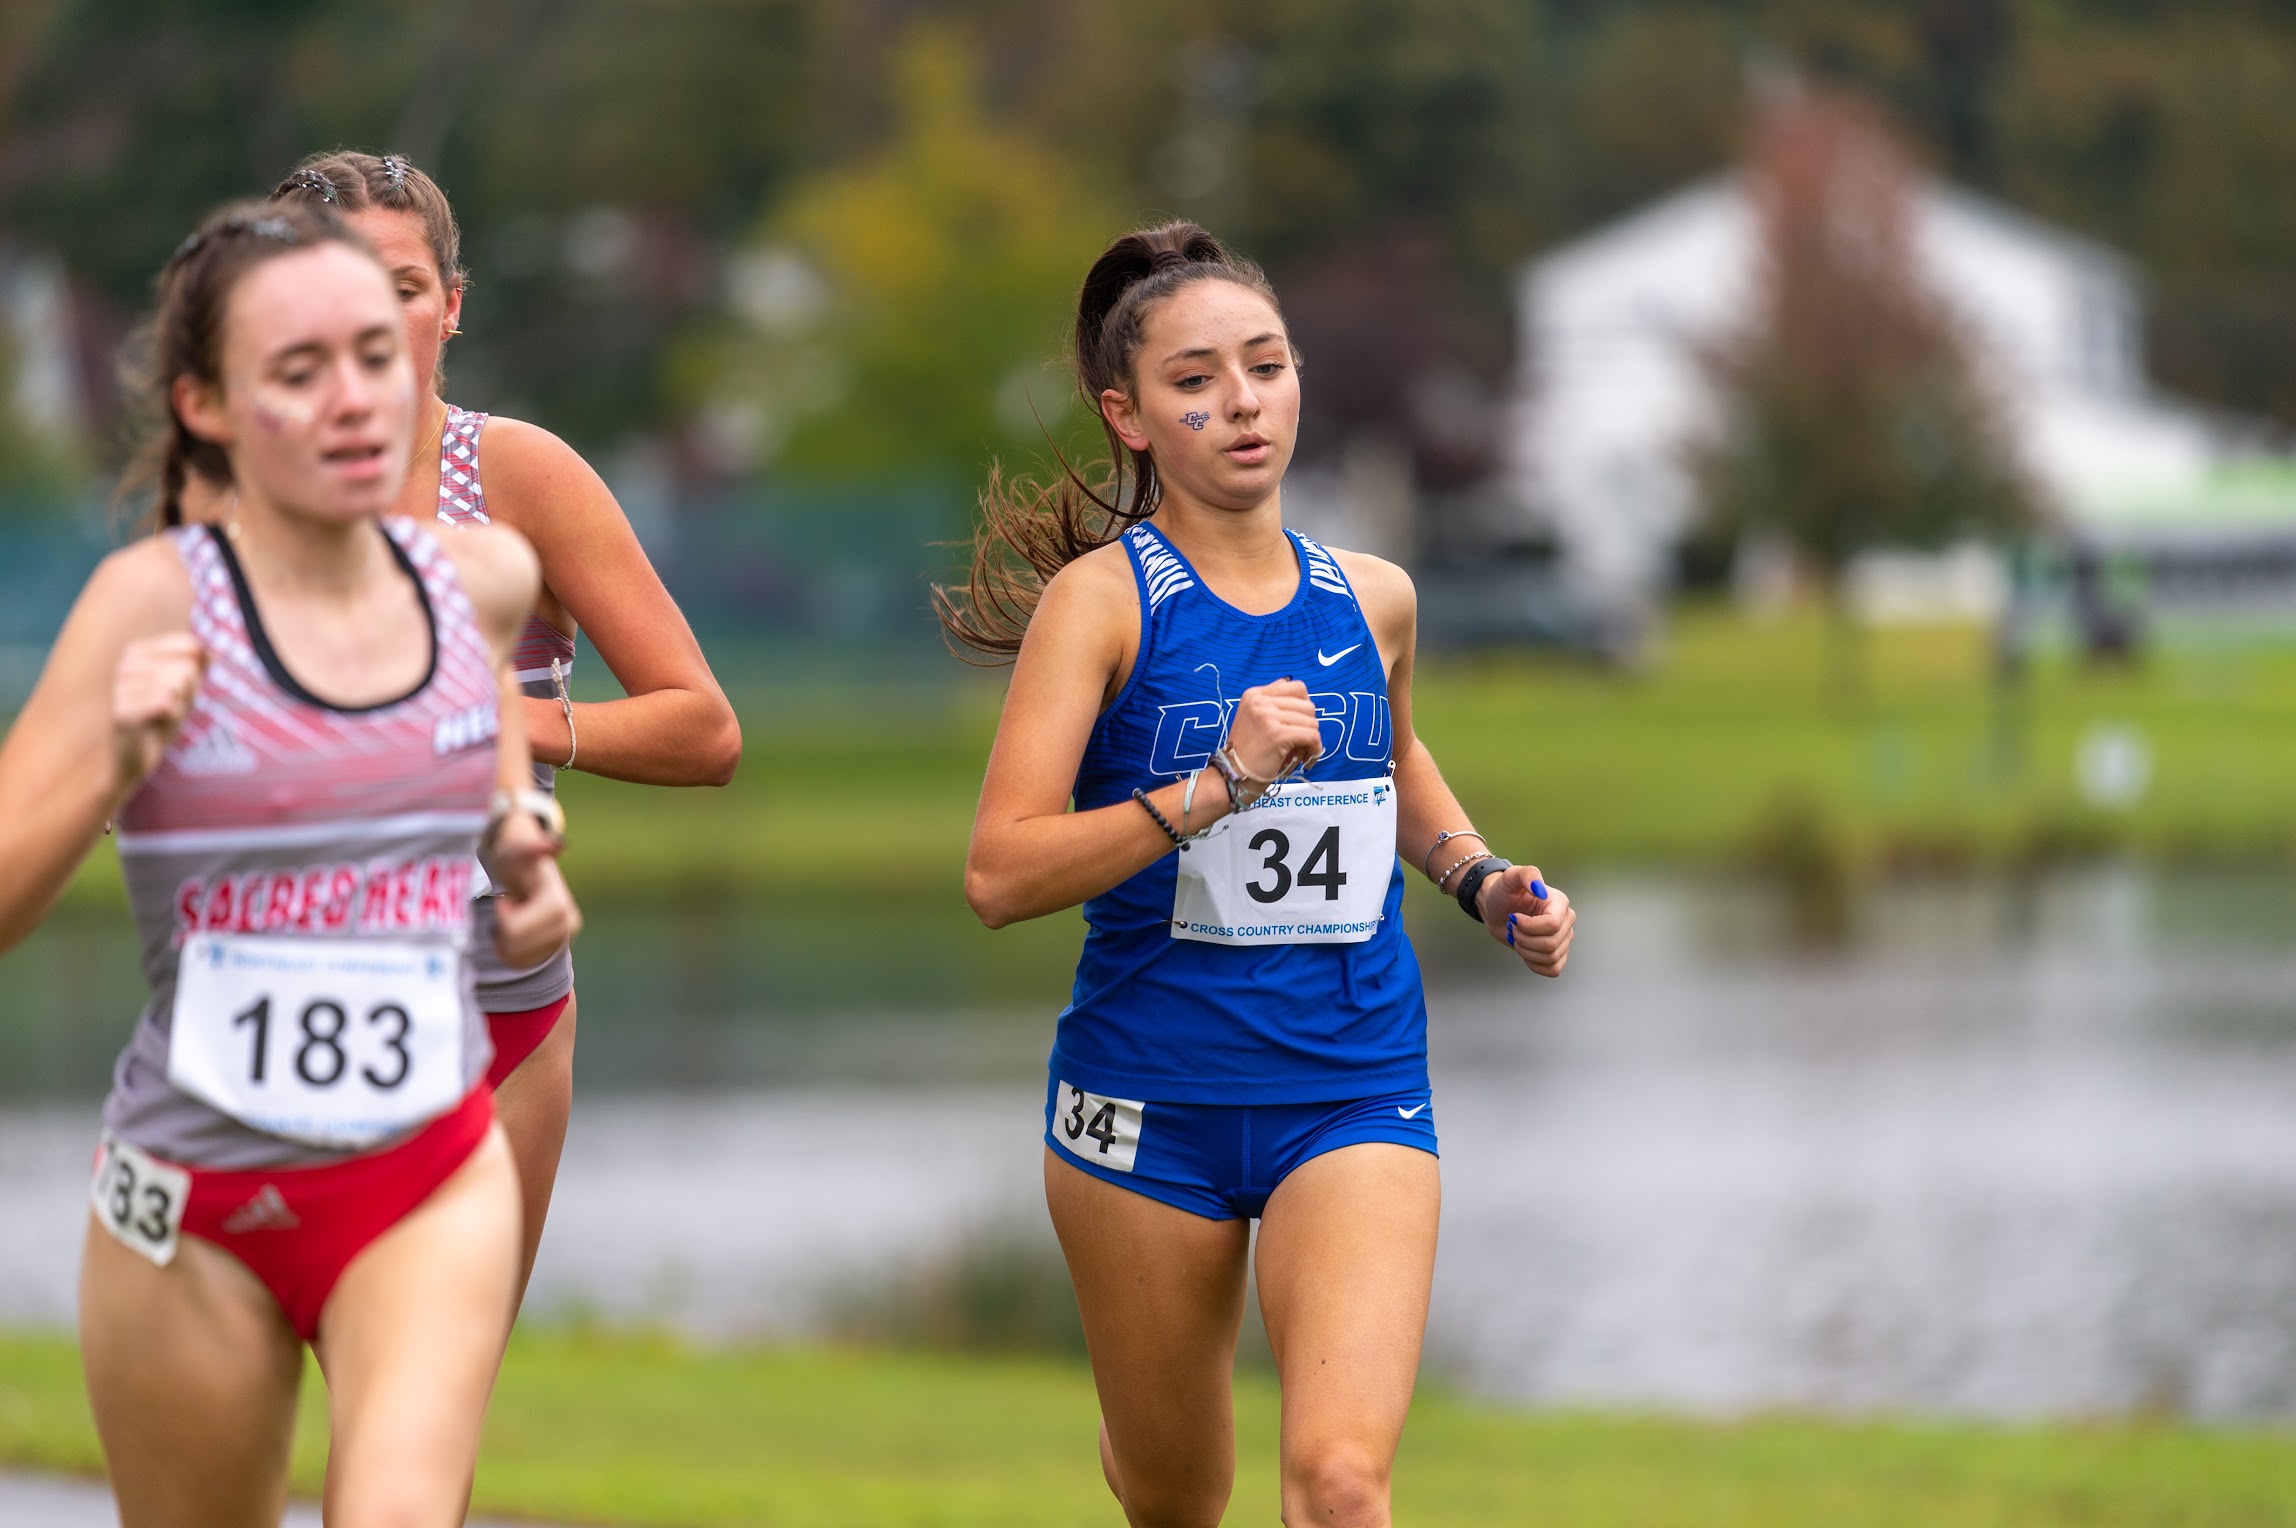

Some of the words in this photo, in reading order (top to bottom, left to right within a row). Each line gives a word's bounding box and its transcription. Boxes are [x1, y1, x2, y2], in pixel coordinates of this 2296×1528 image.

[1150, 692, 1393, 775] CSU
[1253, 797, 1291, 808] HEAST
[1294, 793, 1369, 807] CONFERENCE
[1245, 826, 1347, 904] 34
[174, 864, 359, 946] SACRED
[1190, 922, 1234, 937] CROSS
[1237, 924, 1294, 937] COUNTRY
[232, 992, 412, 1090] 183
[1064, 1086, 1117, 1155] 34
